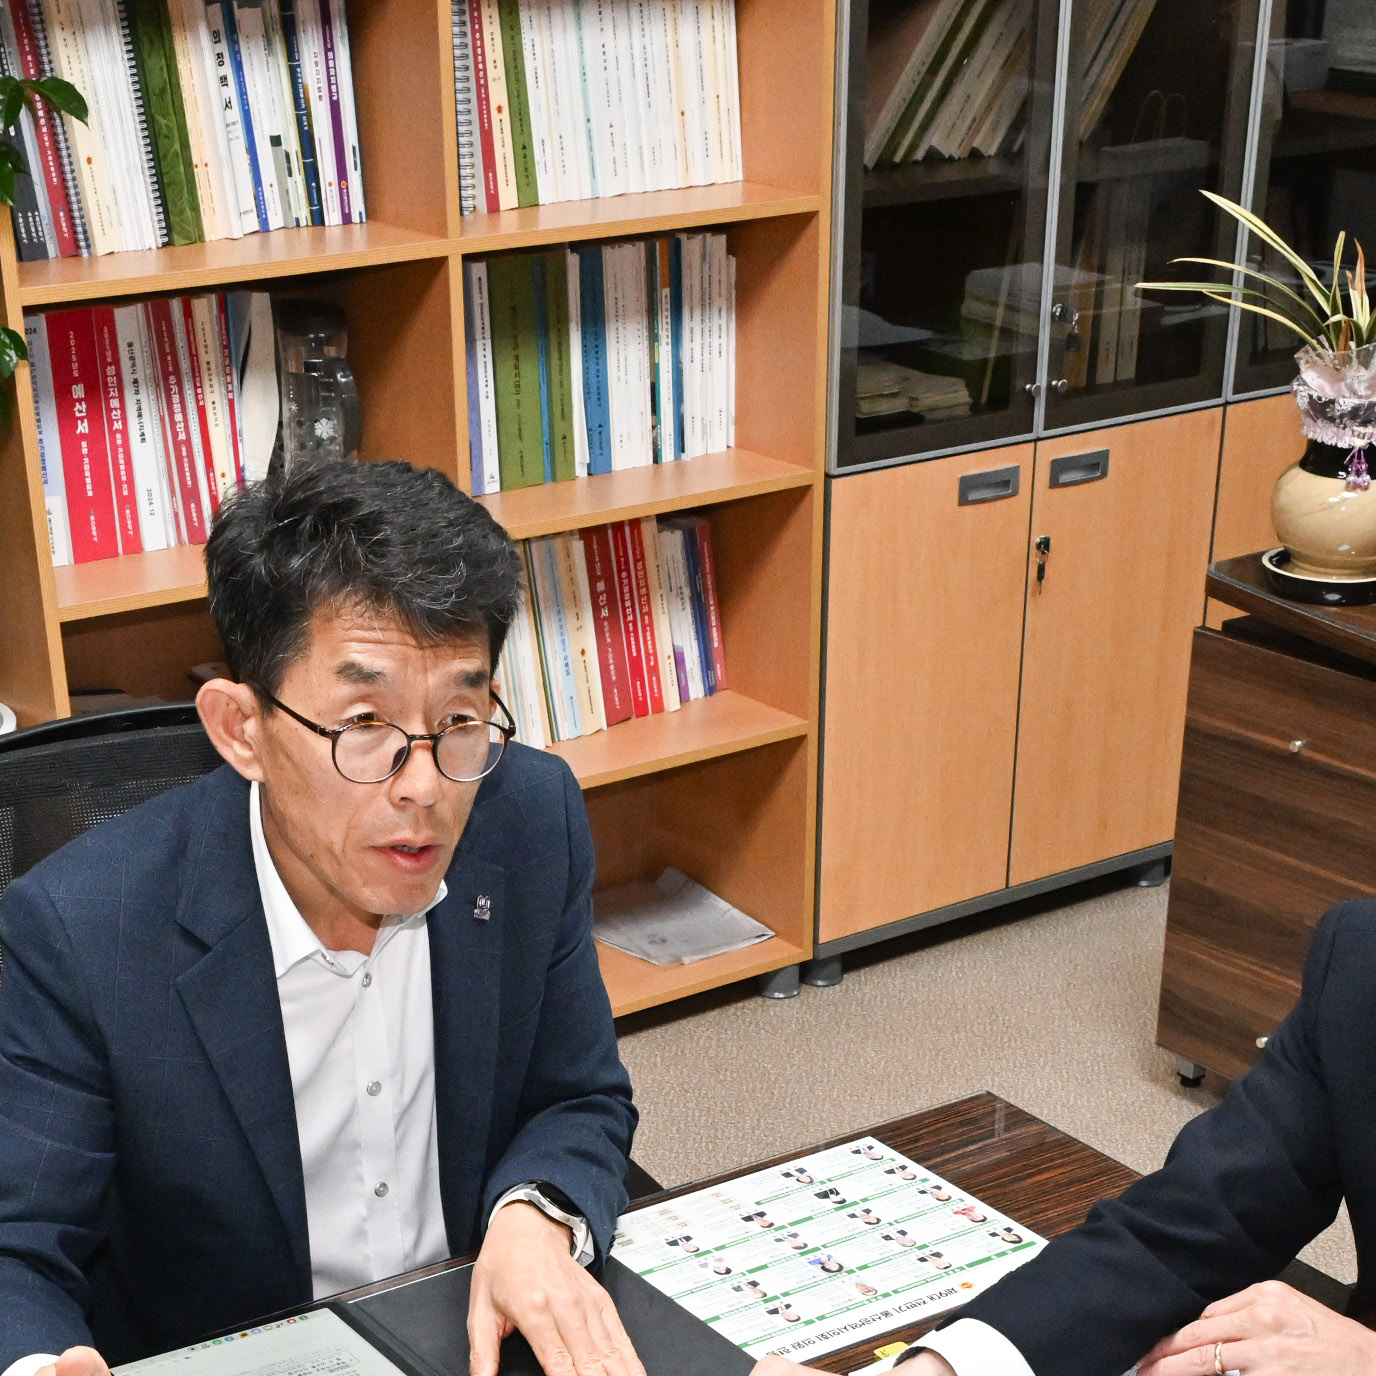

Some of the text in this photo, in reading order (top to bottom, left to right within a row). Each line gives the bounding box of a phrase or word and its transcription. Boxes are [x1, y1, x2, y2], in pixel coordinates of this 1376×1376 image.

[212, 28, 233, 111] 의정백서
[72, 383, 90, 435] 예산서
[106, 365, 123, 431] 성인지예산서
[169, 375, 187, 441] 추가경정예산서
[596, 579, 610, 618] 예산서
[894, 1298, 928, 1317] 전반기
[929, 1286, 960, 1304] 제9대
[817, 1307, 895, 1343] 울산광역시의회
